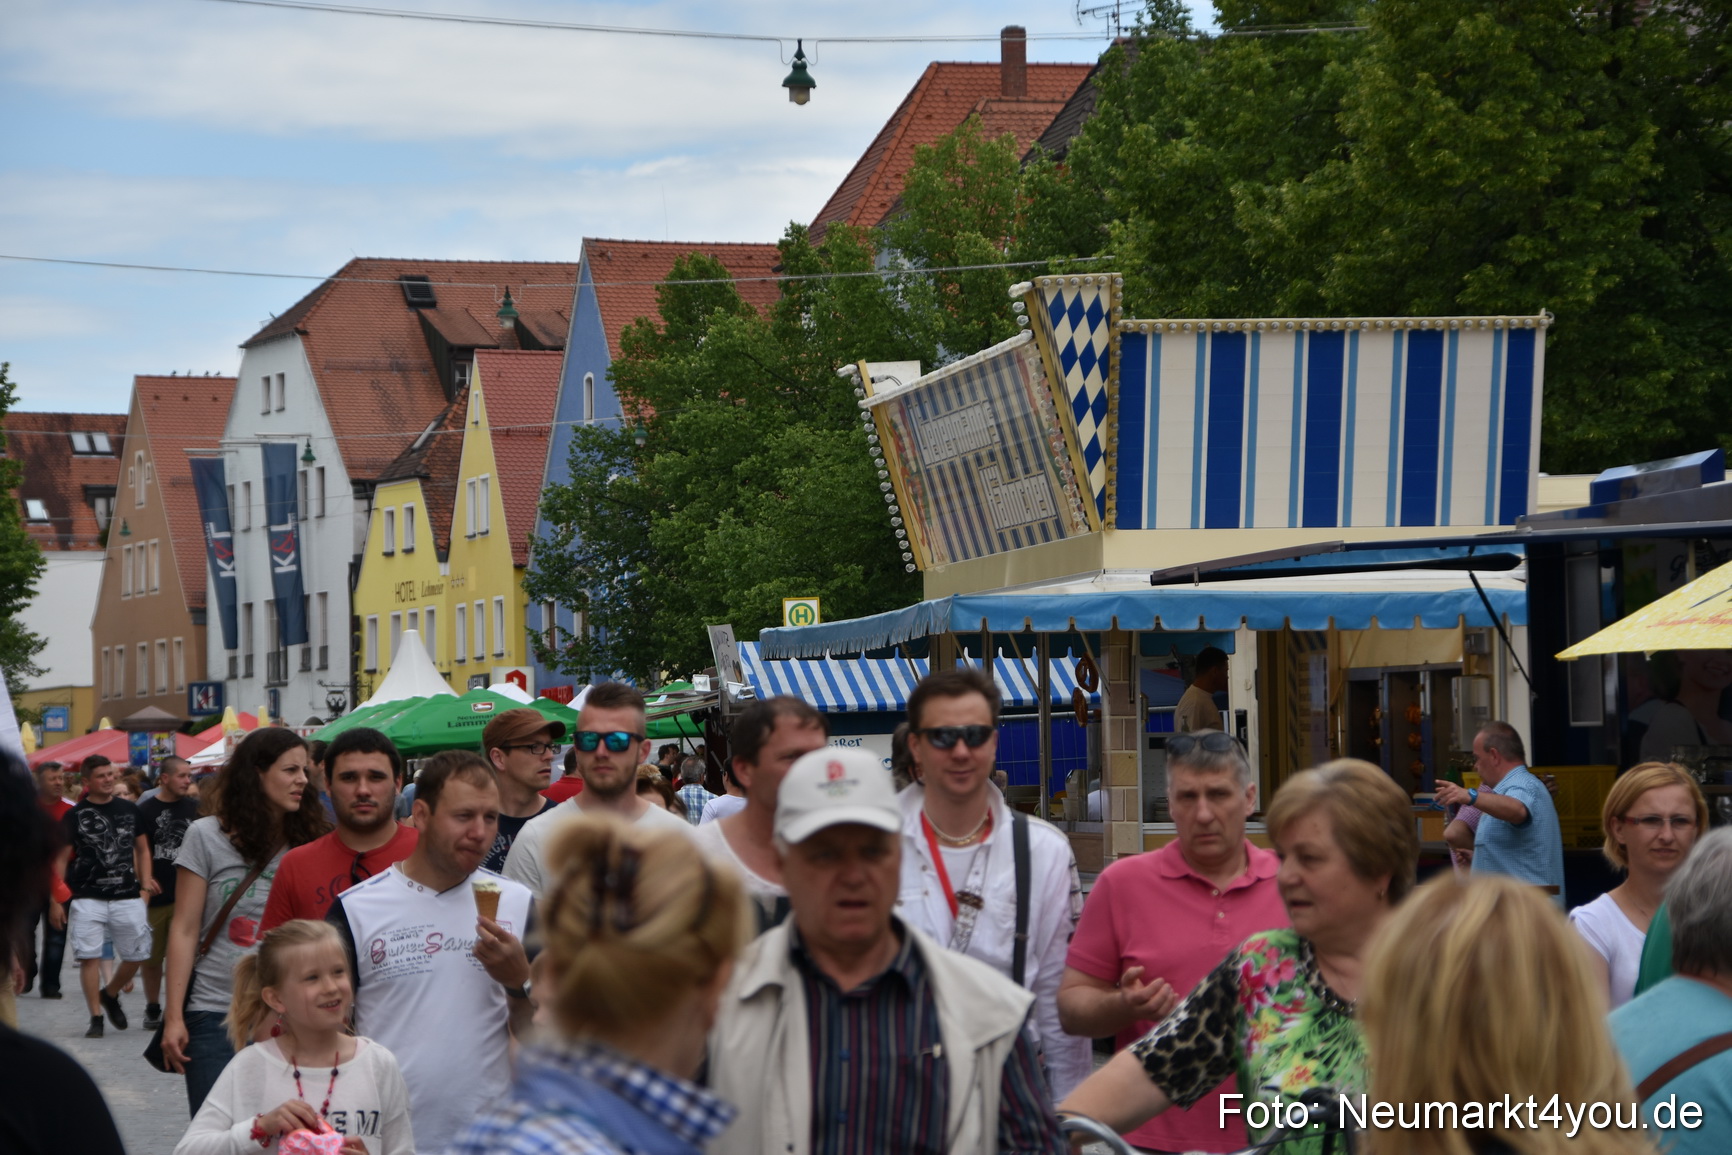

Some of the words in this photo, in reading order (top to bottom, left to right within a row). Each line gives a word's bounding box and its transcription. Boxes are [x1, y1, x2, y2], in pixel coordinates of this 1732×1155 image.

[978, 457, 1058, 531] Hähnchen
[270, 513, 297, 573] K&L
[394, 580, 417, 602] HOTEL
[795, 609, 809, 623] H
[447, 719, 489, 729] Lamm
[828, 737, 863, 748] ißer
[355, 1110, 382, 1138] M
